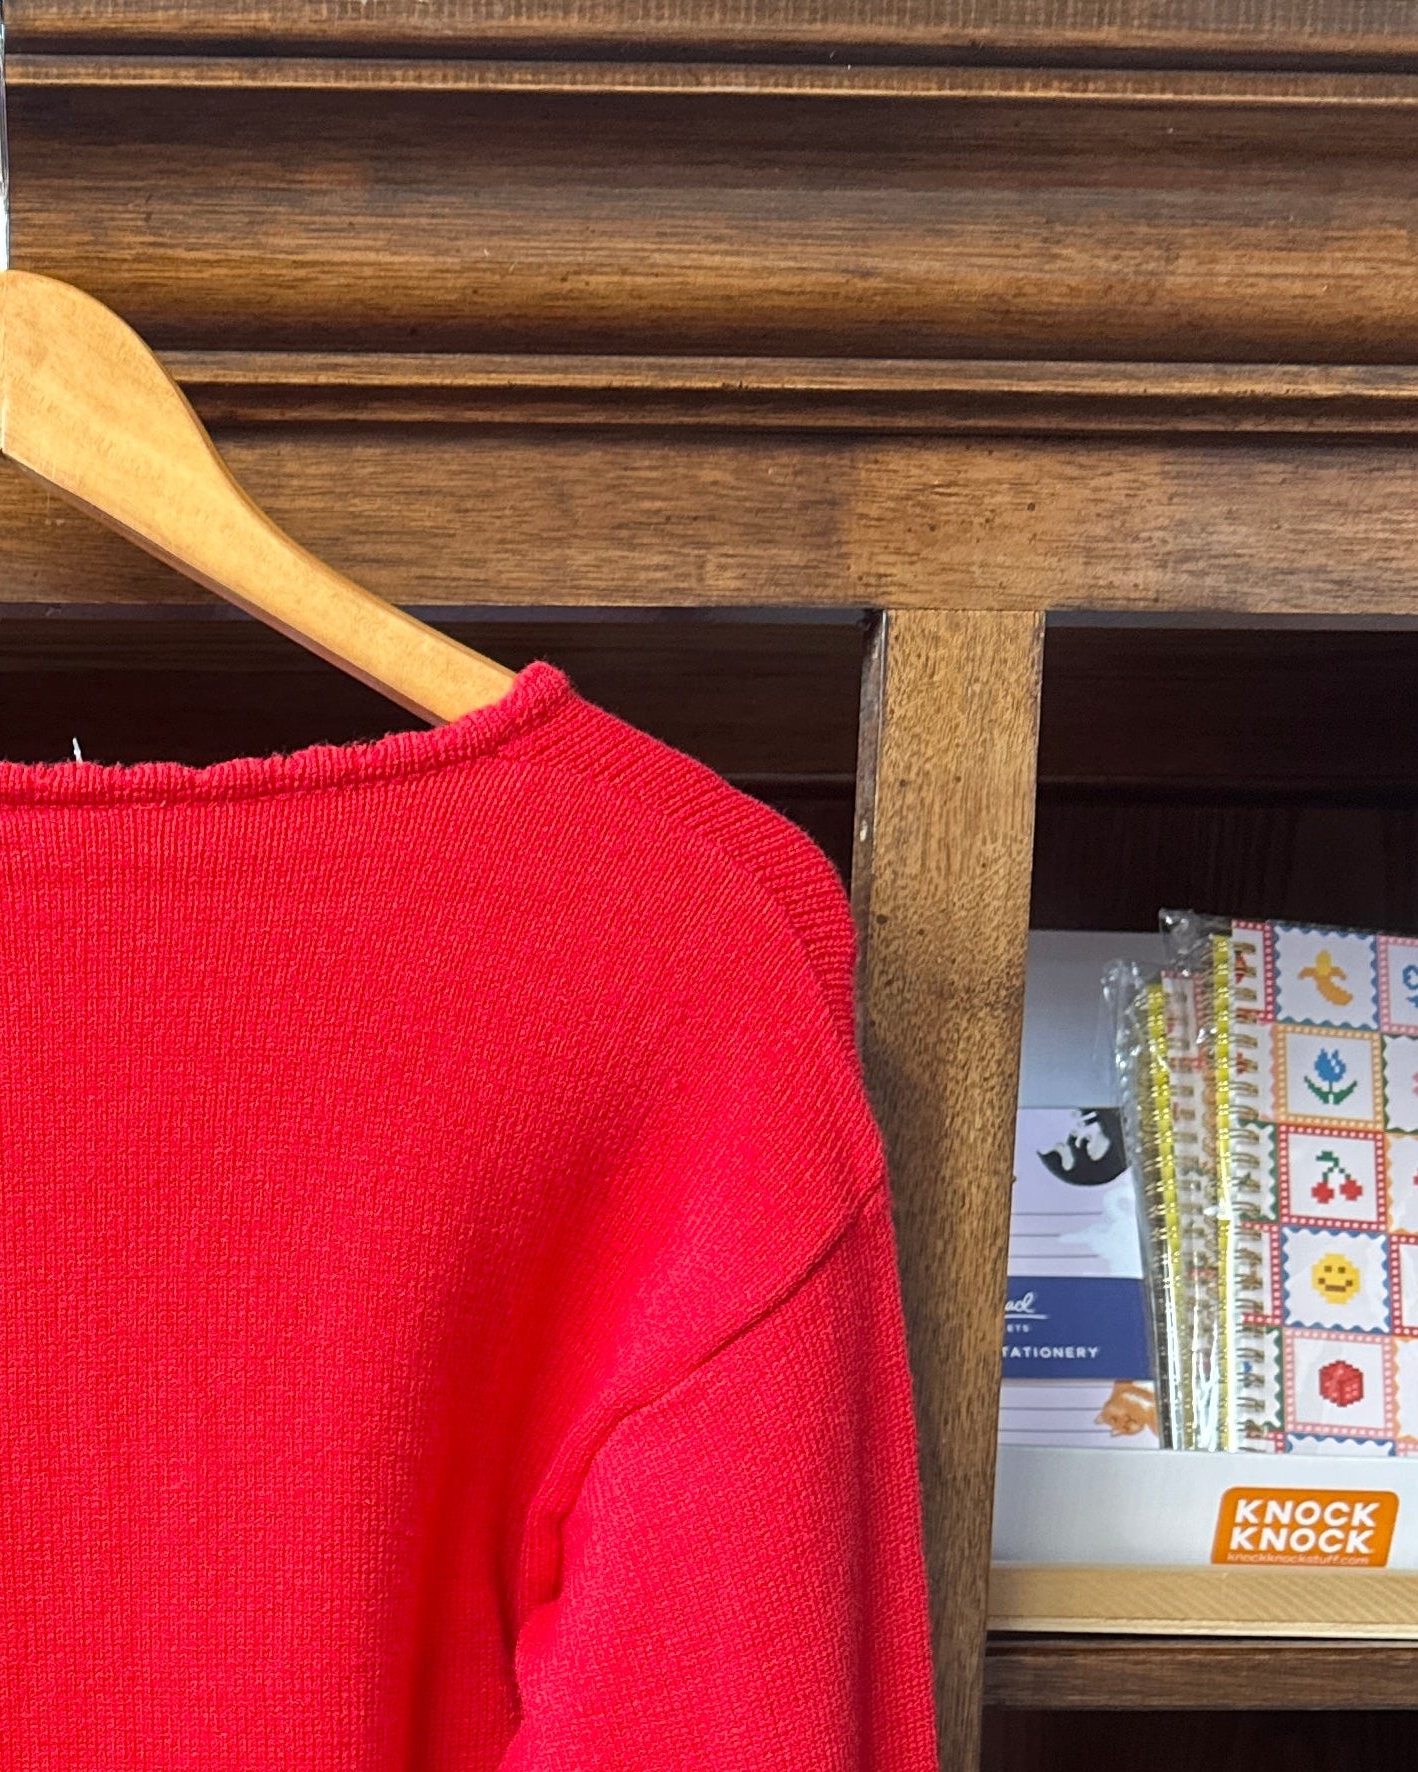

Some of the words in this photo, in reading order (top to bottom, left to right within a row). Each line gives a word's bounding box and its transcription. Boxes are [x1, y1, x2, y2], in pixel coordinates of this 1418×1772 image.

[1007, 1324, 1030, 1333] ETS
[1002, 1346, 1100, 1359] TATIONERY
[1235, 1499, 1380, 1527] KNOCK
[1230, 1526, 1375, 1554] KNOCK
